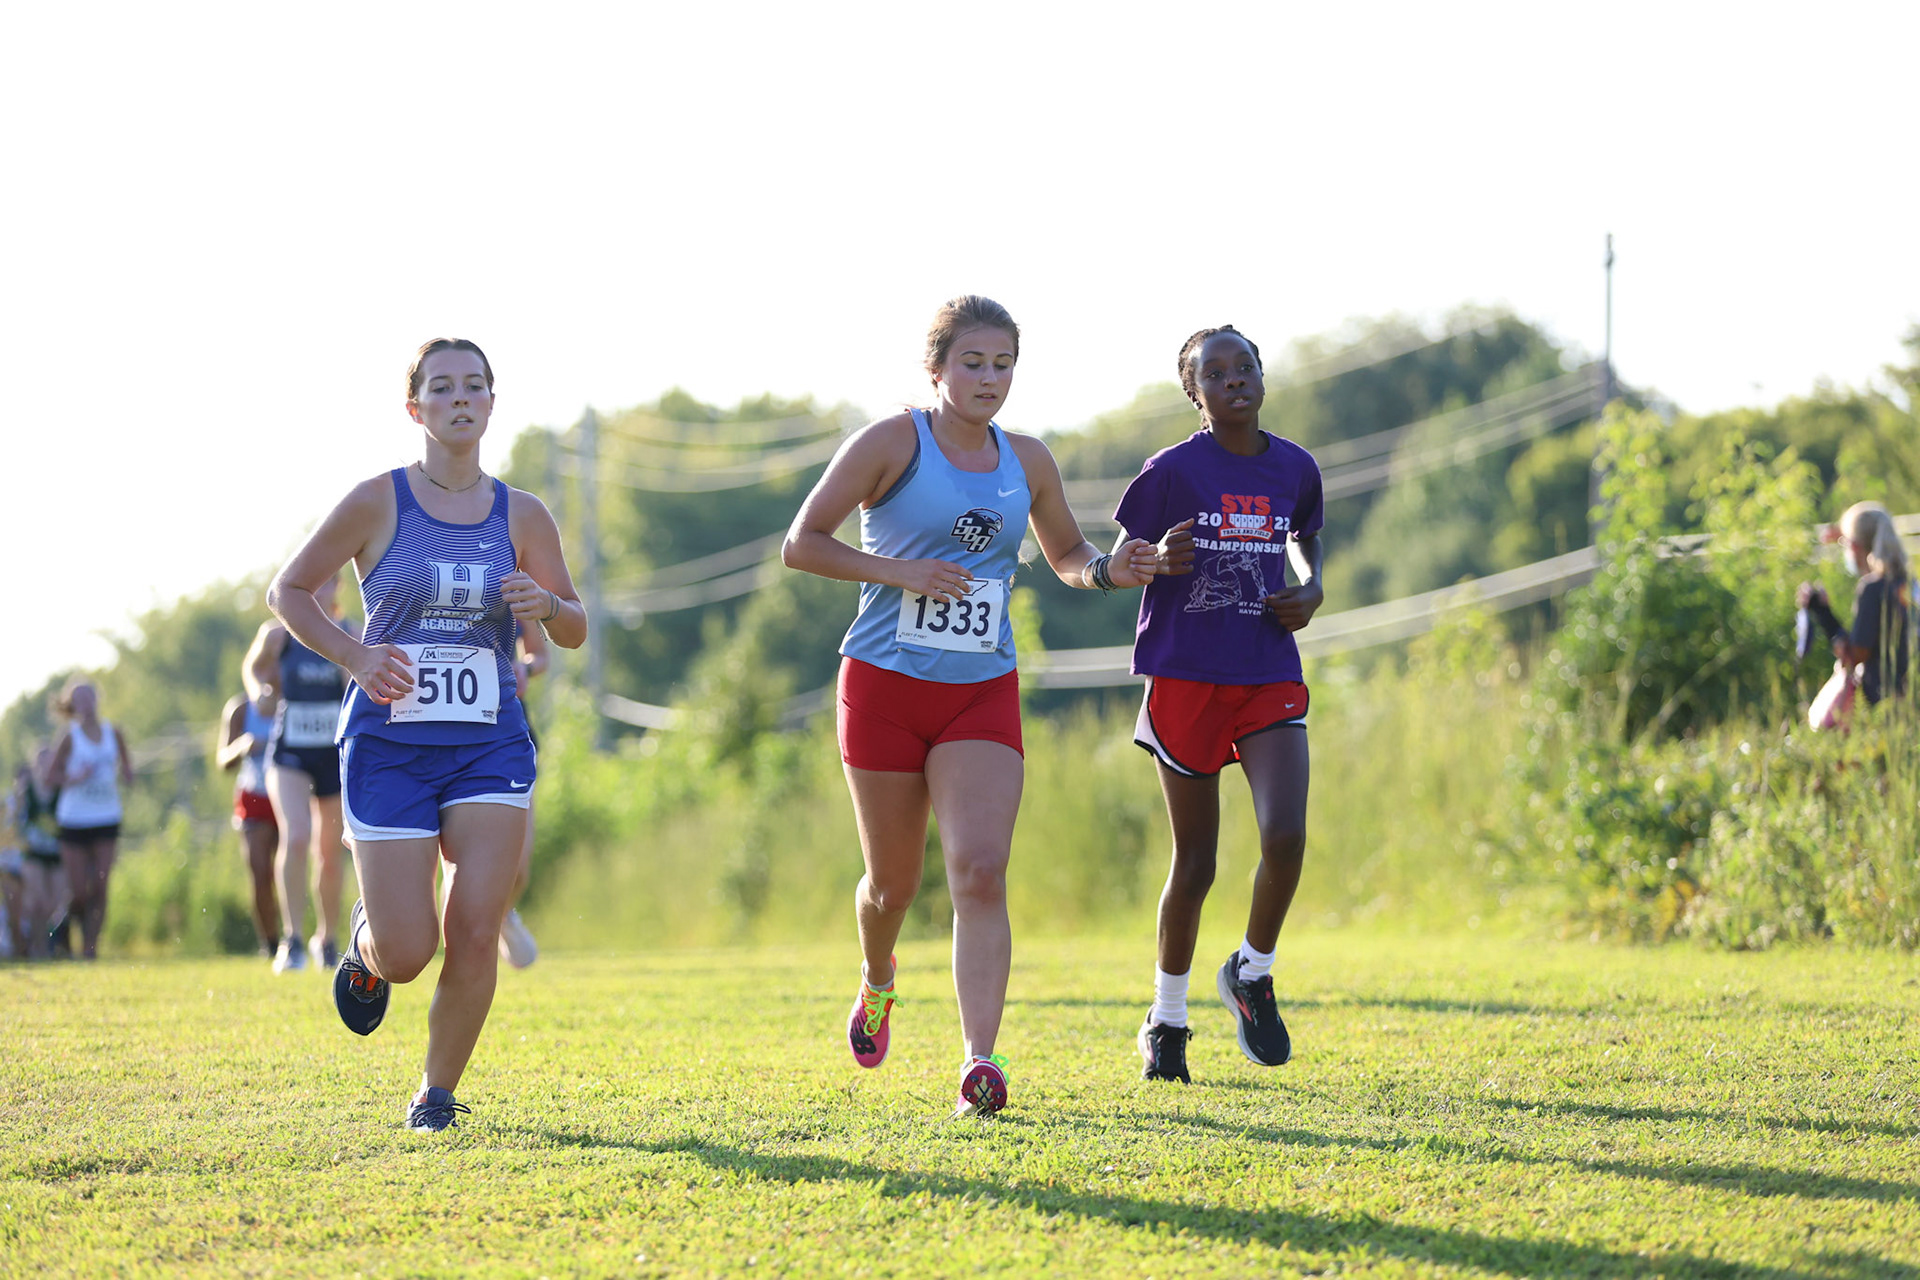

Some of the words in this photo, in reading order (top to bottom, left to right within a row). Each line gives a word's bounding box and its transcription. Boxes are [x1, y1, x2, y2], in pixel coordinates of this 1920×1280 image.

[1198, 512, 1222, 527] 20
[1221, 493, 1271, 515] SYS
[954, 517, 992, 552] SBA
[915, 595, 991, 637] 1333
[417, 667, 478, 705] 510
